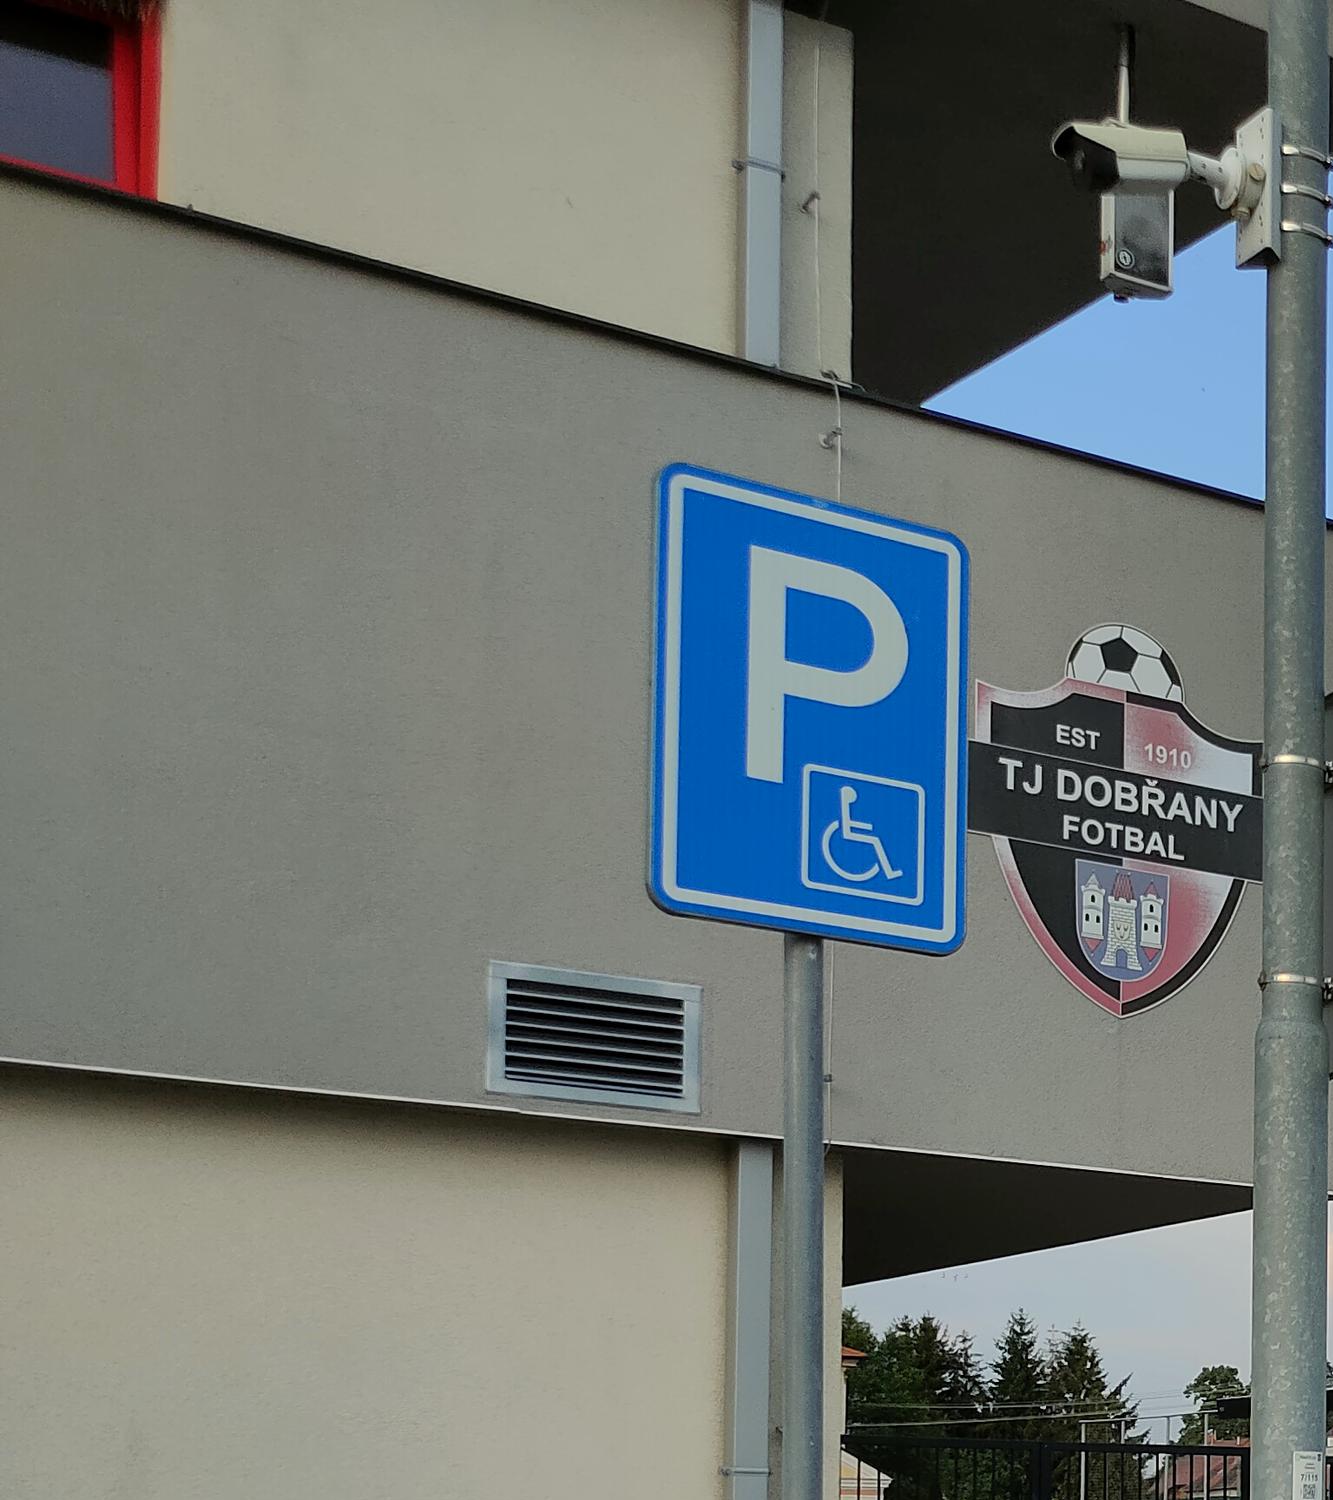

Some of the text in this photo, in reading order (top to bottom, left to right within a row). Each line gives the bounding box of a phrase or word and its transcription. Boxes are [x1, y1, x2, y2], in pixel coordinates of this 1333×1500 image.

[746, 545, 909, 784] P
[1056, 724, 1101, 750] EST
[1144, 743, 1192, 769] 1910
[999, 757, 1244, 833] TJ DOBŘANY
[1062, 814, 1185, 861] FOTBAL
